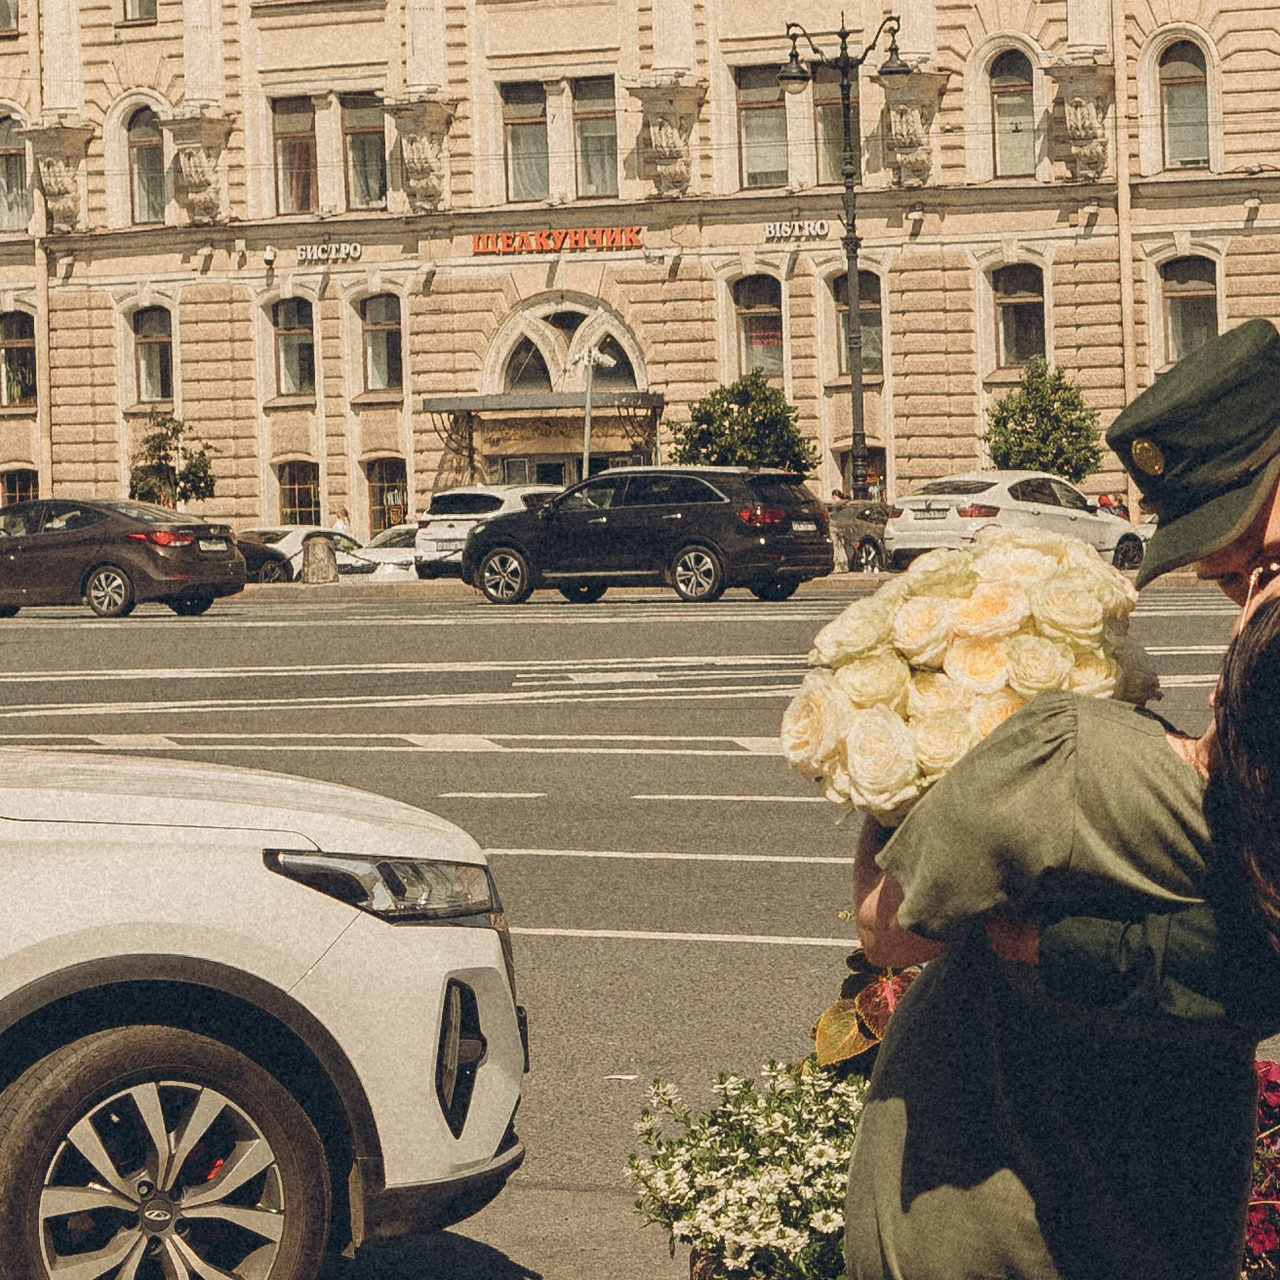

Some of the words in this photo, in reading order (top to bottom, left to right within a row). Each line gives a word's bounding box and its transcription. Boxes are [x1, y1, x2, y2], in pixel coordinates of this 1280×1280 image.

[765, 220, 830, 239] BISTRO
[472, 227, 644, 255] ЩЕЛКУНЧИК
[296, 243, 362, 262] БИСТРО
